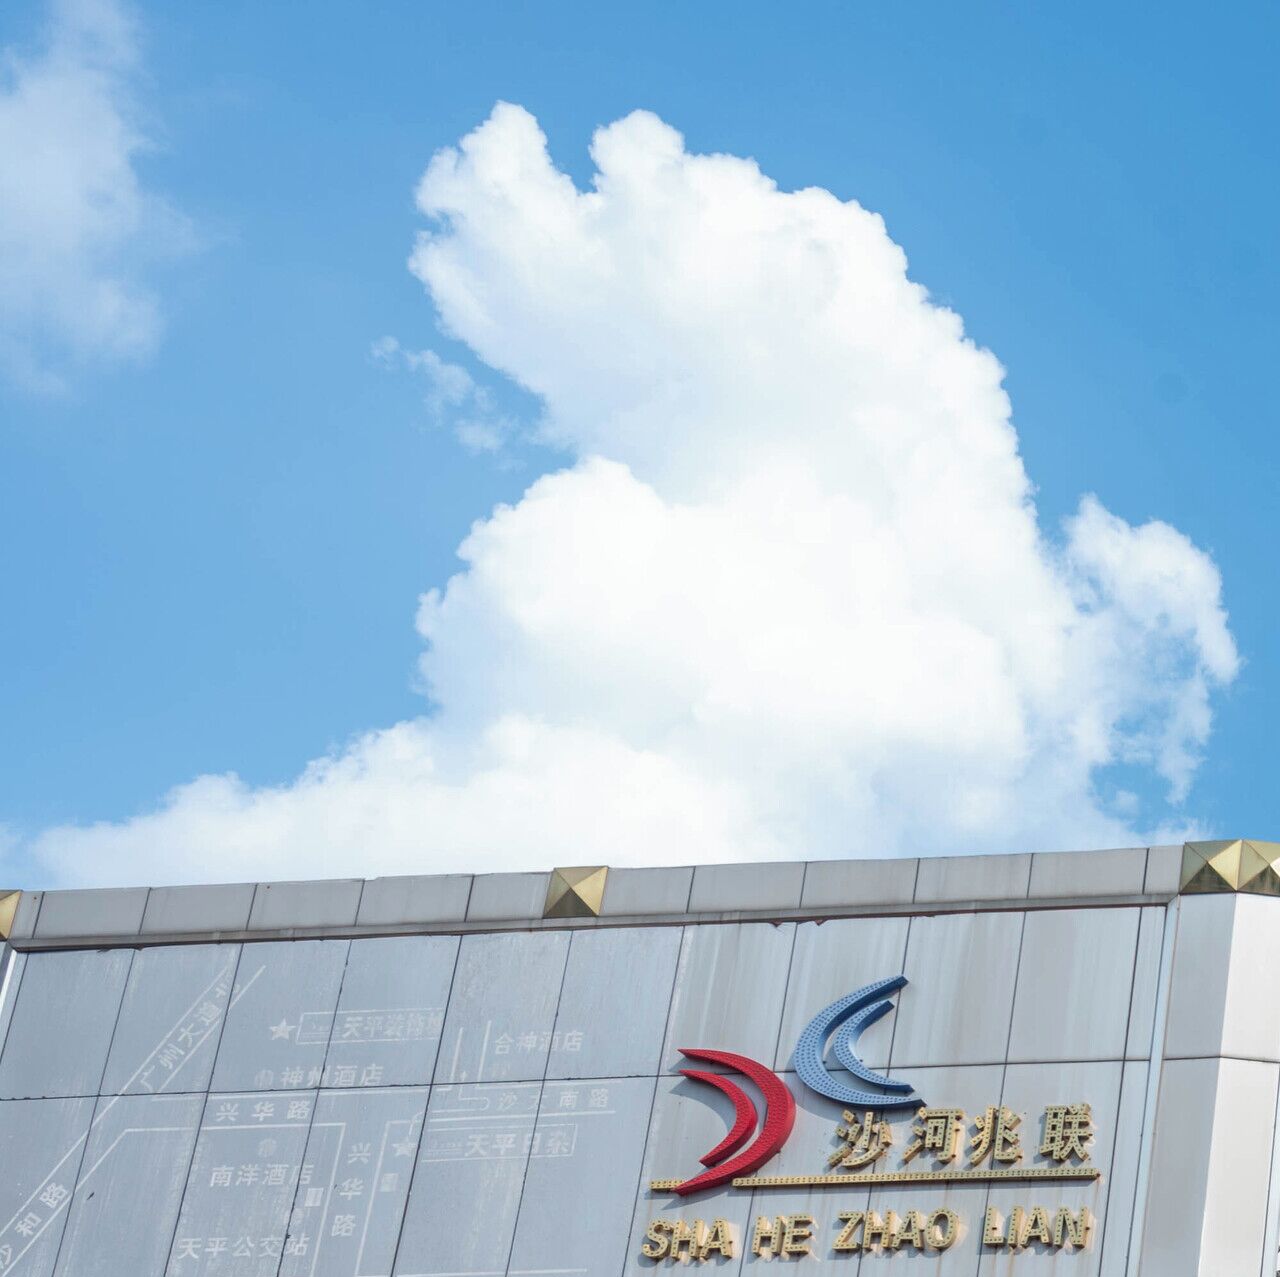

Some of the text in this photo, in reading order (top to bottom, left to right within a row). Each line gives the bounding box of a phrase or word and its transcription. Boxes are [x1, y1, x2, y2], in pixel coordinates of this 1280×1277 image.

[279, 1063, 385, 1089] 神州酒店
[215, 1098, 313, 1123] 兴华路
[828, 1102, 1093, 1170] 沙河兆联
[209, 1161, 314, 1188] 南洋酒店
[331, 1142, 372, 1239] 兴华路
[177, 1233, 311, 1261] 天平公交站
[641, 1206, 1090, 1262] SHA HE ZHAO LIAN
